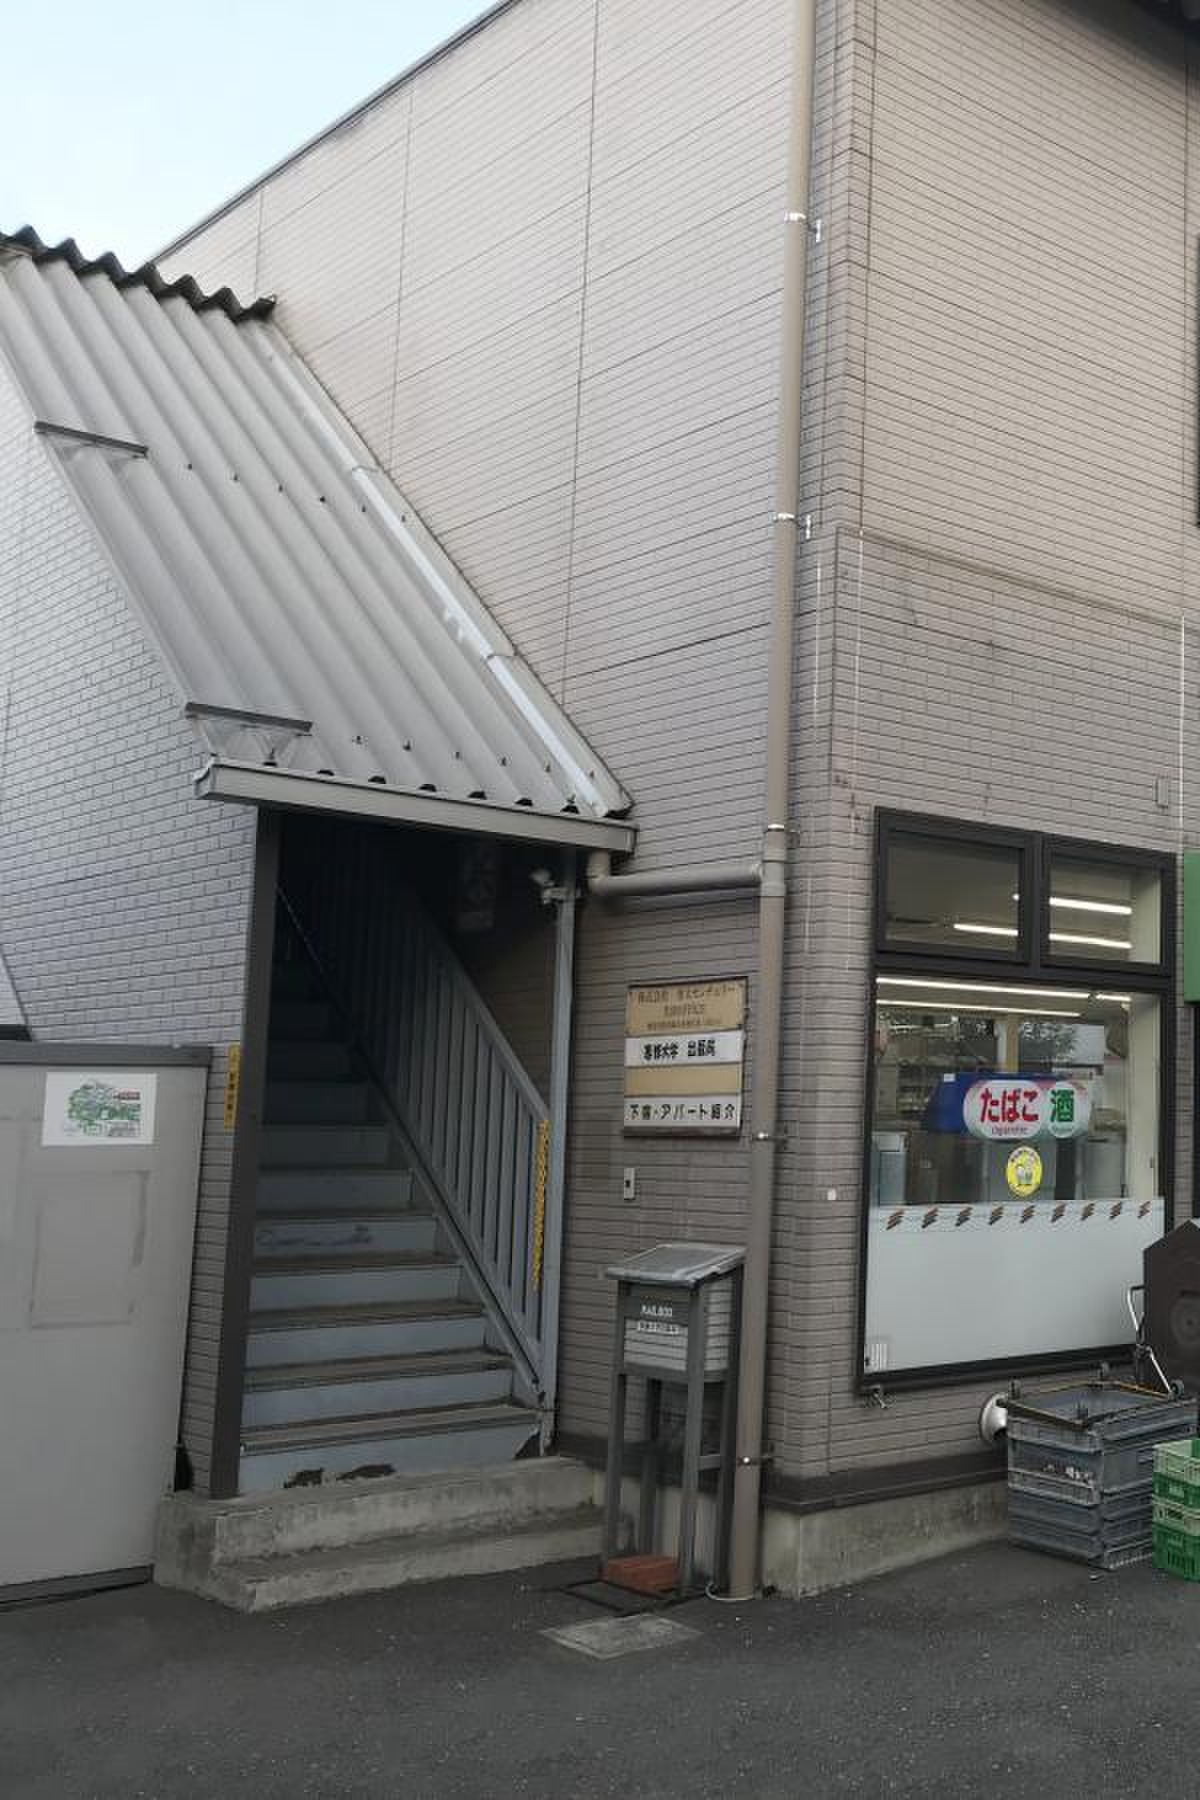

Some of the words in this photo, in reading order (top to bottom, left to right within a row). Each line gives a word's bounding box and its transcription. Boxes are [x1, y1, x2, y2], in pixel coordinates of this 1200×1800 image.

[980, 1088, 1040, 1123] たばこ
[1049, 1088, 1075, 1123] 酒
